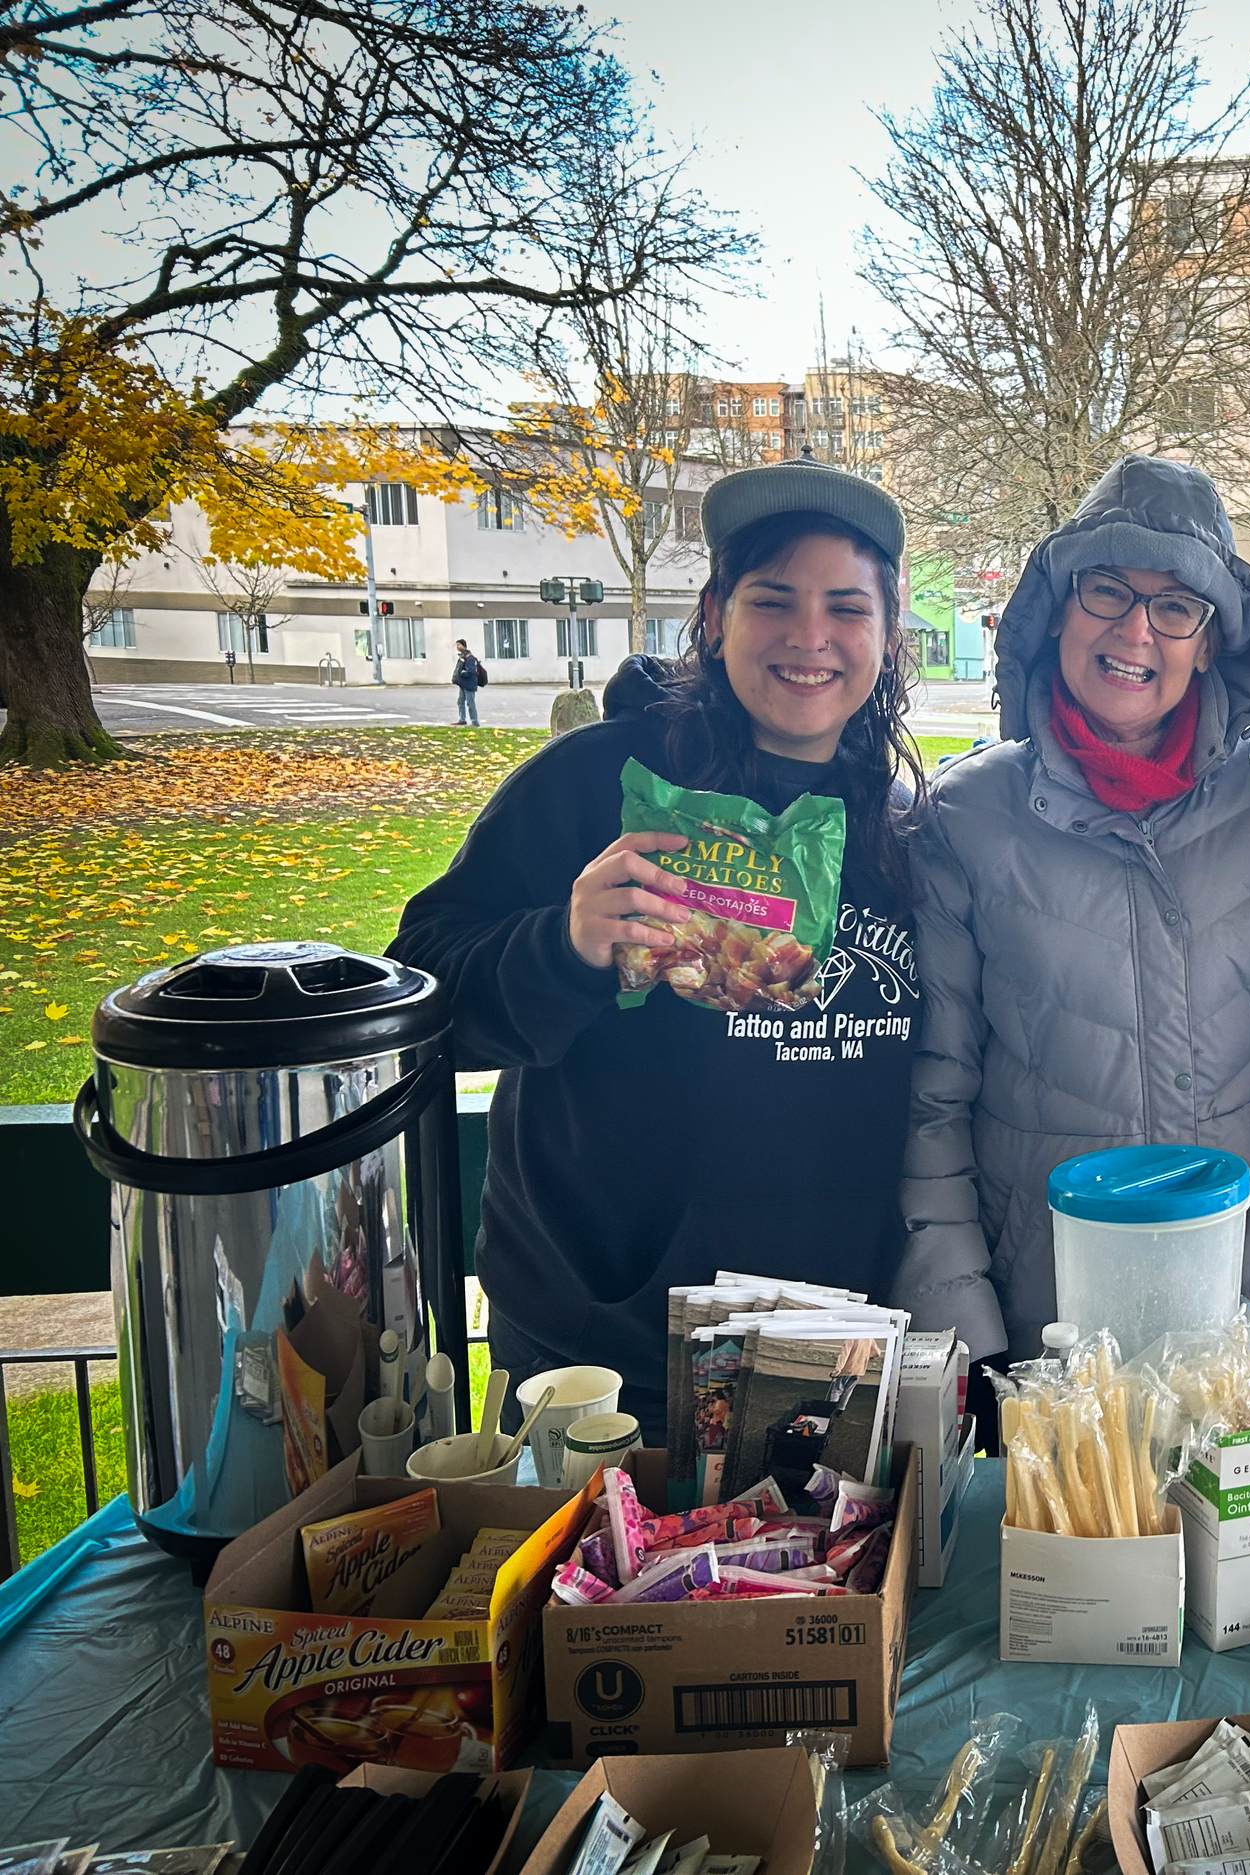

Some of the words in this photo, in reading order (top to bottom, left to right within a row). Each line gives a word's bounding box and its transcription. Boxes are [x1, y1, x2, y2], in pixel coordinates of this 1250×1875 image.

[667, 841, 785, 874] IMPLY
[659, 854, 783, 894] POTATOES
[709, 894, 768, 917] POTATOES
[725, 1011, 784, 1038] Tattoo
[790, 1014, 828, 1039] and
[834, 1011, 911, 1041] Piercing
[775, 1041, 835, 1062] Tacoma,
[841, 1040, 864, 1059] WA
[1232, 1436, 1248, 1445] FIRST
[309, 1526, 354, 1548] ALPINE
[326, 1527, 365, 1564] Spiced
[479, 1545, 513, 1556] ALPIN
[324, 1531, 391, 1599] Apple
[209, 1608, 274, 1634] ALPINE
[809, 1615, 838, 1624] 36000
[1223, 1622, 1240, 1634] 144
[291, 1621, 350, 1648] Spiced
[566, 1627, 602, 1644] 8/16's
[602, 1624, 663, 1636] COMPACT
[602, 1635, 645, 1644] unscented
[646, 1635, 682, 1643] tampons
[785, 1626, 835, 1645] 51581
[841, 1626, 861, 1643] 01
[214, 1643, 230, 1659] 48
[233, 1642, 344, 1693] Apple
[348, 1628, 443, 1668] Cider
[324, 1674, 396, 1695] ORIGINAL
[595, 1670, 623, 1700] U
[729, 1672, 770, 1682] CARTONS
[771, 1671, 800, 1680] INSIDE
[589, 1724, 634, 1736] CLICK
[738, 1730, 774, 1738] 36000
